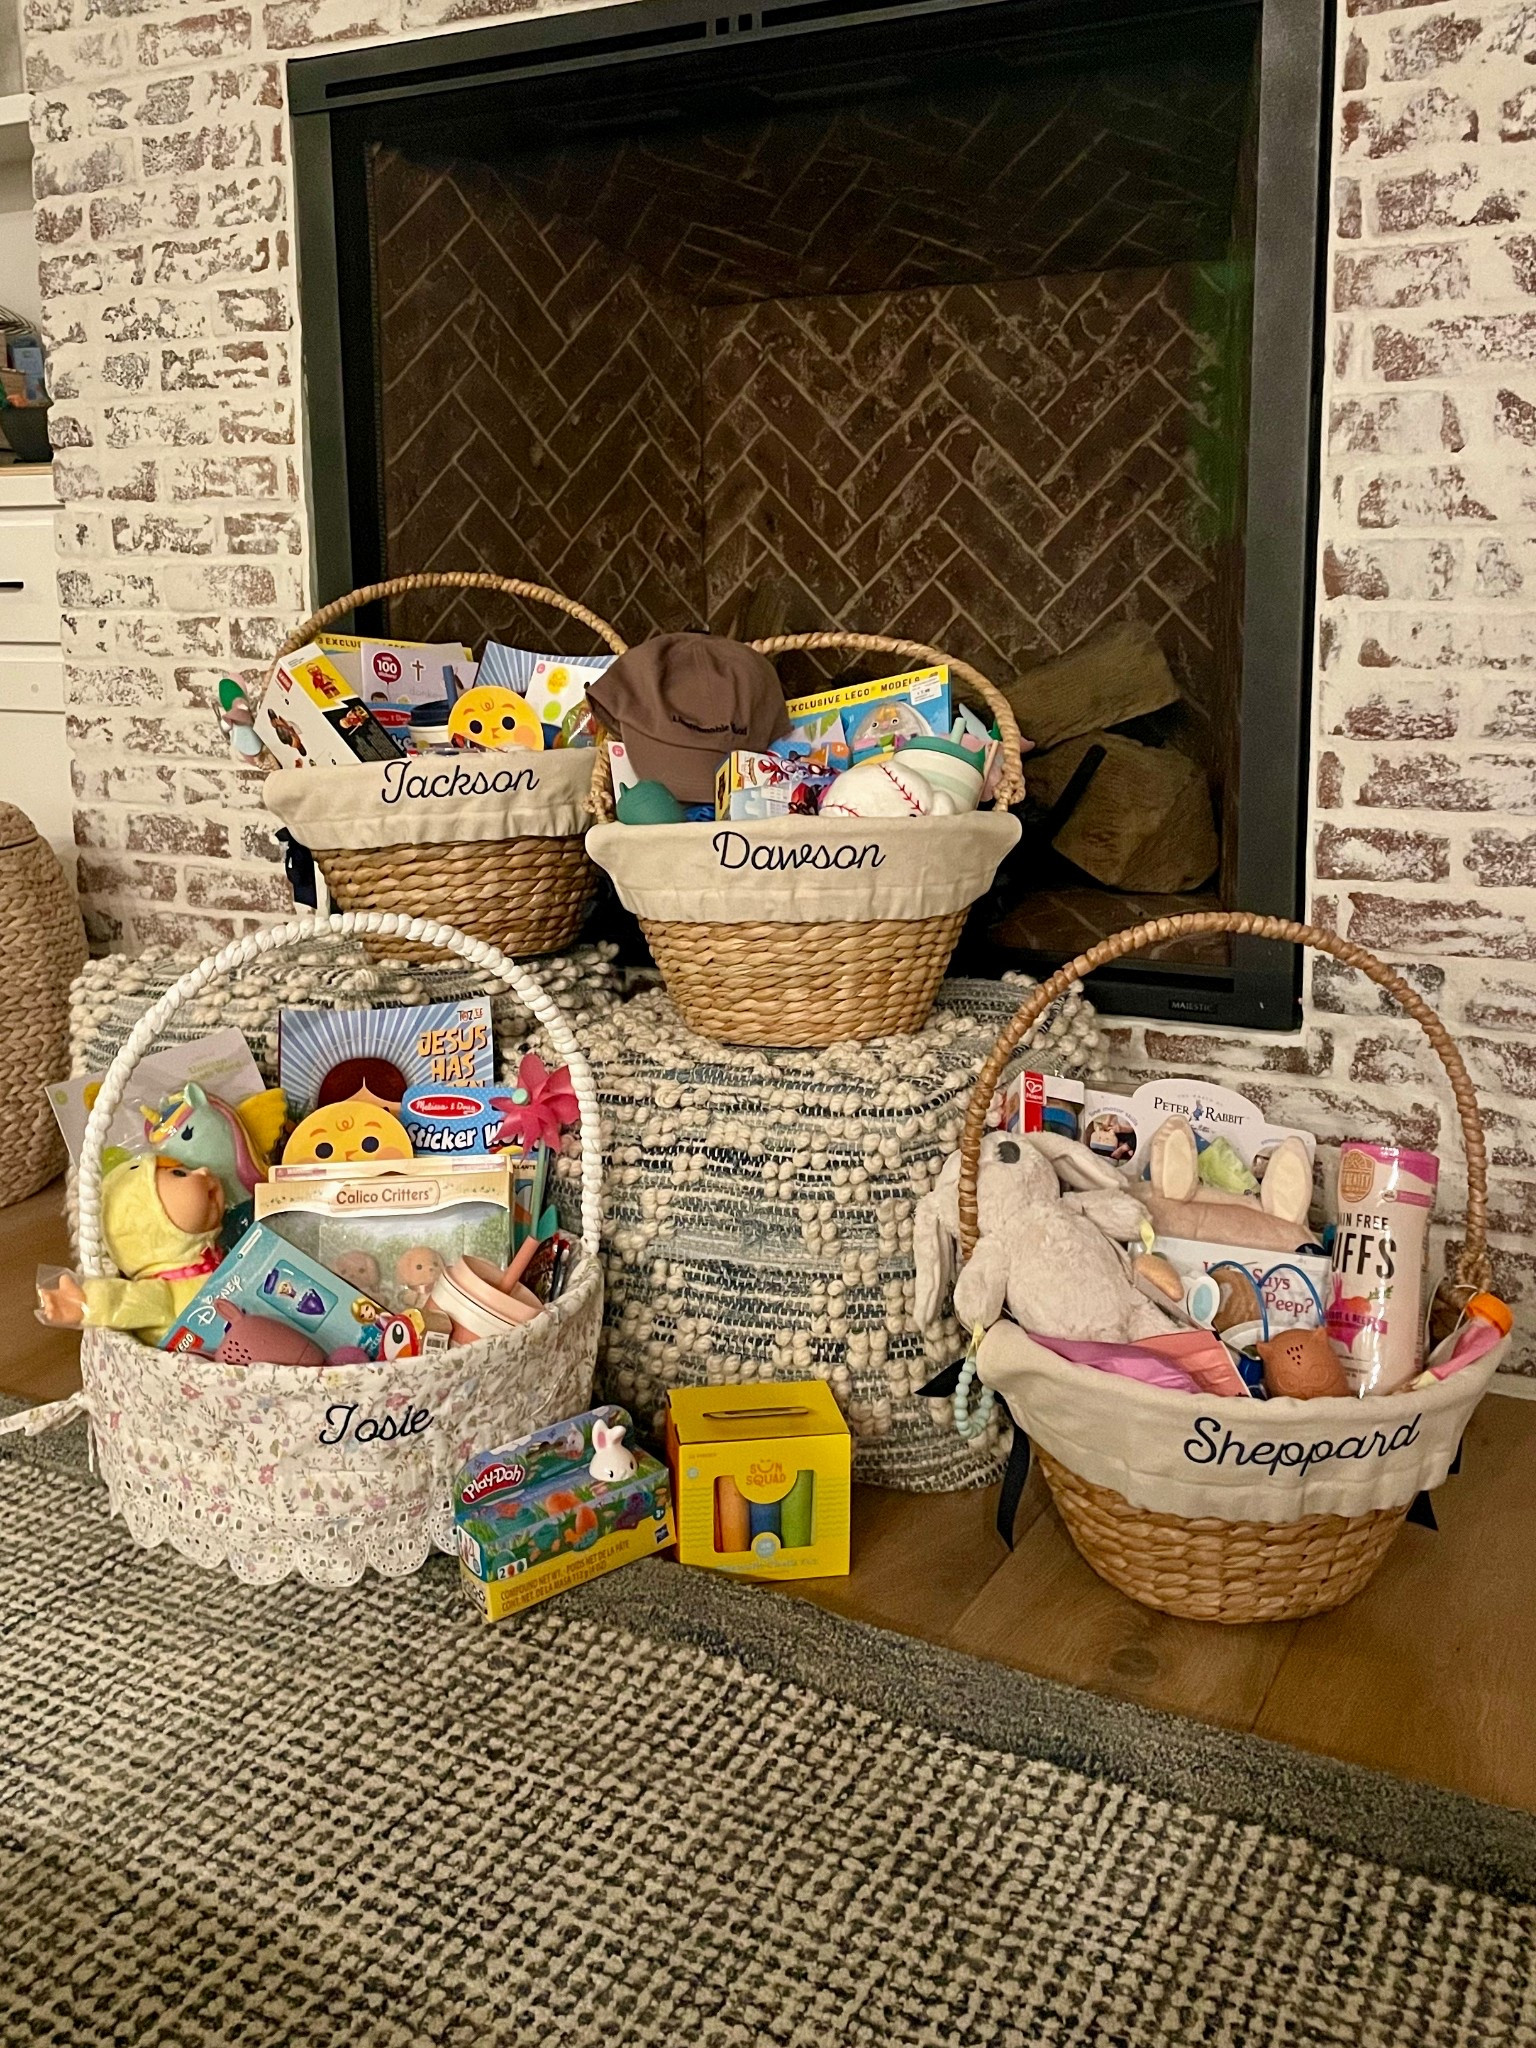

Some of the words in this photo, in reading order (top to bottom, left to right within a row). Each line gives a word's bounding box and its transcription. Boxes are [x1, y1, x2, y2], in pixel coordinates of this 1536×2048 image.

[377, 660, 397, 674] 100
[845, 688, 870, 702] LEGO
[381, 761, 539, 804] Jackson
[713, 831, 886, 870] Dawson
[417, 1023, 488, 1058] JESUS
[431, 1053, 476, 1083] HAS
[1154, 1097, 1189, 1115] PETER
[1205, 1107, 1244, 1125] RABBIT
[406, 1123, 477, 1151] Sticker
[336, 1188, 378, 1206] Calico
[382, 1187, 430, 1203] Critters
[1356, 1214, 1389, 1231] FREE
[1332, 1232, 1397, 1279] UFFS
[1265, 1292, 1314, 1317] Peep?
[319, 1403, 433, 1446] Josie
[1184, 1413, 1422, 1477] Sheppard
[746, 1473, 786, 1487] SQUAD
[499, 1568, 506, 1579] 2
